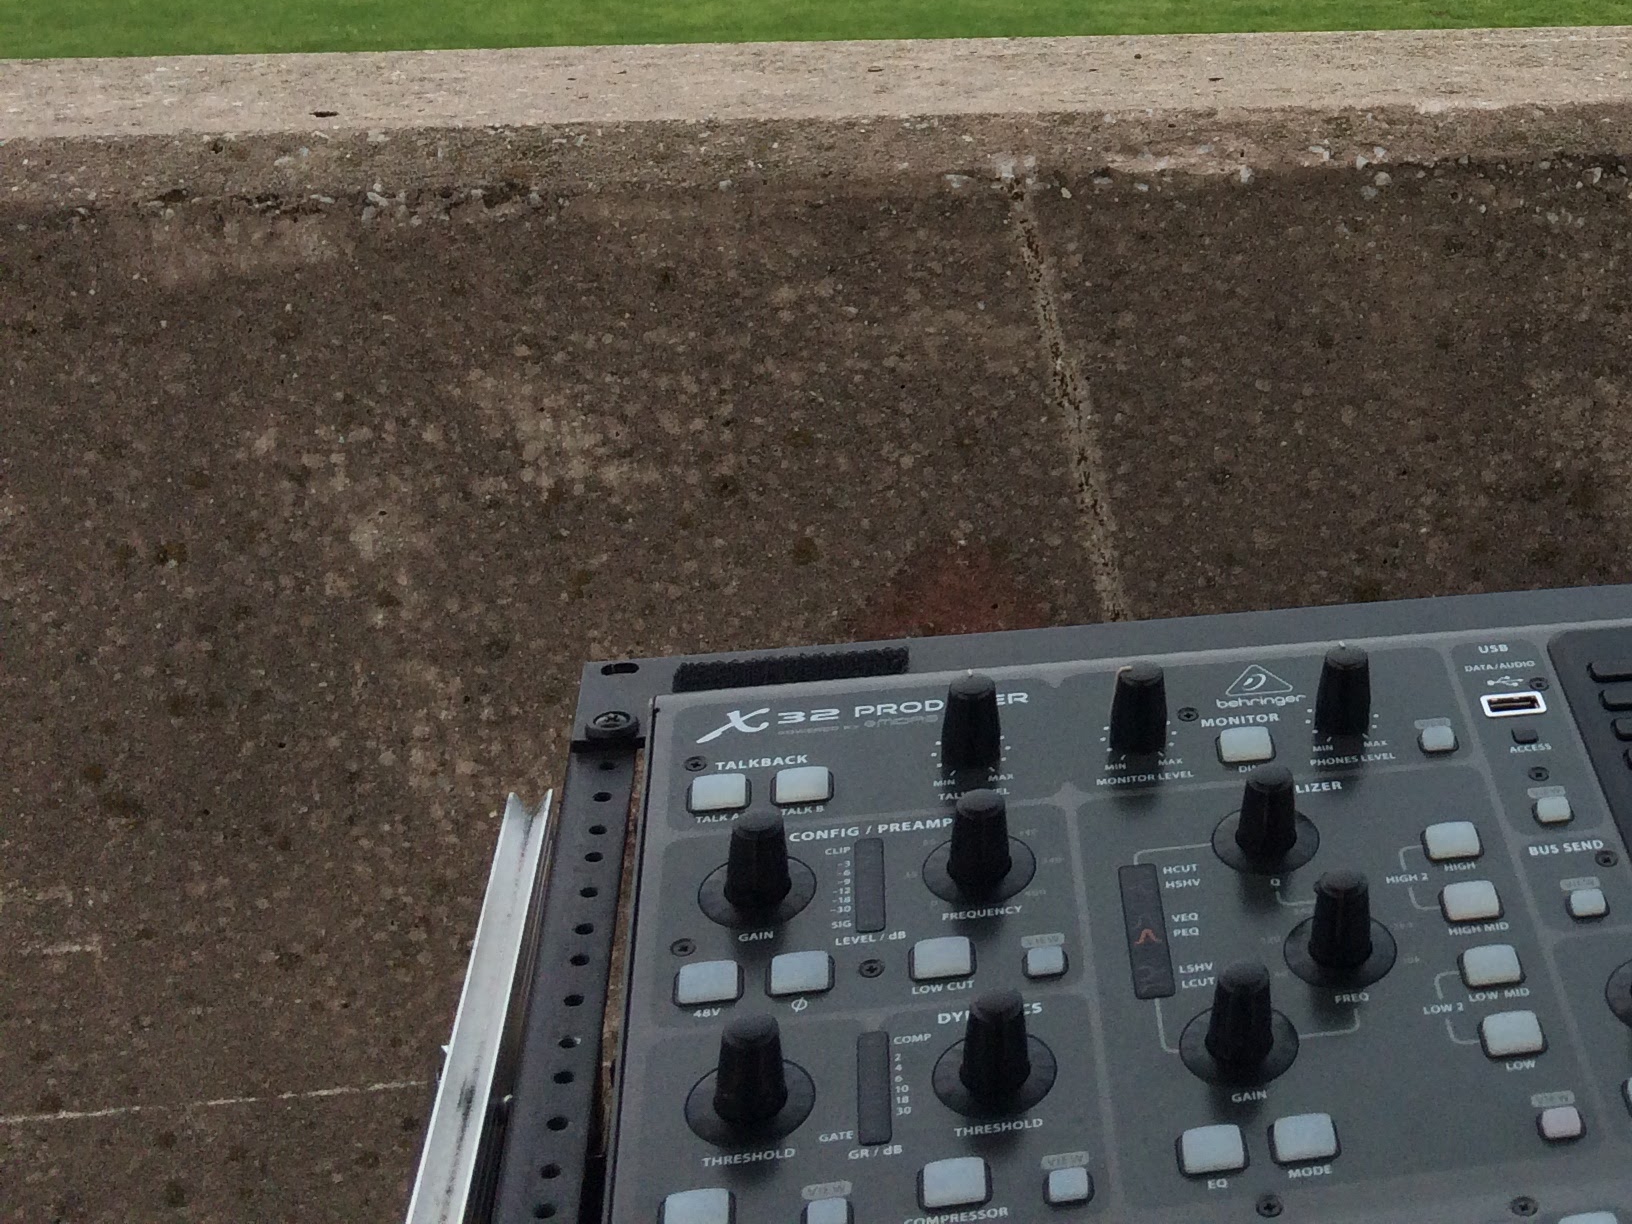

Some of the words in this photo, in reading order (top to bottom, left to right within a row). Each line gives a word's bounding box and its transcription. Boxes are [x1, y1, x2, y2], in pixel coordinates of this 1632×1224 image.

[1478, 644, 1509, 654] USB
[1464, 660, 1536, 672] DATA/AUDIO
[854, 691, 1029, 719] PRODER
[1216, 694, 1306, 709] behringer
[1201, 712, 1280, 728] MONITOR
[1313, 743, 1334, 752] MIN
[1363, 739, 1388, 748] MAX
[1509, 743, 1552, 754] ACCESS
[715, 754, 809, 770] TALKBACK
[1104, 762, 1127, 771] MIN
[1158, 758, 1183, 766] MAX
[1309, 754, 1358, 767] PHONES
[1361, 751, 1396, 762] LEVEL
[933, 779, 956, 787] MIN
[987, 773, 1014, 782] MAX
[1096, 774, 1155, 785] MONITOR
[1158, 770, 1195, 780] LEVEL
[780, 806, 812, 816] TALK
[816, 805, 825, 814] B
[695, 814, 729, 824] TALK
[731, 813, 741, 822] A
[788, 826, 859, 842] CONFIG
[877, 818, 953, 834] PREAMP
[824, 846, 851, 855] CLIP
[1528, 843, 1560, 856] BUS
[1562, 840, 1604, 853] SEND
[1162, 863, 1198, 874] HCUT
[1443, 862, 1476, 872] HIGH
[1165, 878, 1201, 889] HSHV
[1270, 878, 1281, 887] Q
[1385, 874, 1418, 884] HIGH
[1421, 872, 1429, 881] 2
[942, 905, 1023, 921] FREQUENCY
[1171, 912, 1199, 923] VEQ
[831, 921, 852, 929] SIG
[1448, 925, 1483, 936] HIGH
[1484, 922, 1510, 933] MID
[738, 931, 774, 942] GAIN
[1173, 926, 1200, 937] PEQ
[835, 934, 874, 946] LEVEL
[888, 931, 907, 940] dB
[1178, 962, 1214, 974] LSHV
[911, 983, 943, 995] LOW
[946, 980, 975, 991] CUT
[1181, 977, 1216, 989] LCUT
[1334, 992, 1370, 1004] FREQ
[1468, 992, 1499, 1003] LOW
[1503, 987, 1530, 998] MID
[693, 1007, 721, 1018] 48V
[1422, 1005, 1453, 1015] LOW
[1456, 1002, 1464, 1012] 2
[893, 1032, 932, 1045] COMP
[895, 1053, 902, 1062] 2
[1505, 1059, 1537, 1071] LOW
[895, 1084, 910, 1093] 10
[896, 1095, 910, 1104] 18
[1231, 1090, 1268, 1103] GAIN
[896, 1106, 912, 1115] 30
[953, 1117, 1043, 1137] THRESHOLD
[818, 1130, 854, 1143] GATE
[701, 1147, 796, 1167] THRESHOLD
[848, 1147, 869, 1160] GR
[883, 1145, 903, 1156] dB
[1287, 1164, 1333, 1178] MODE
[1207, 1178, 1229, 1189] EQ
